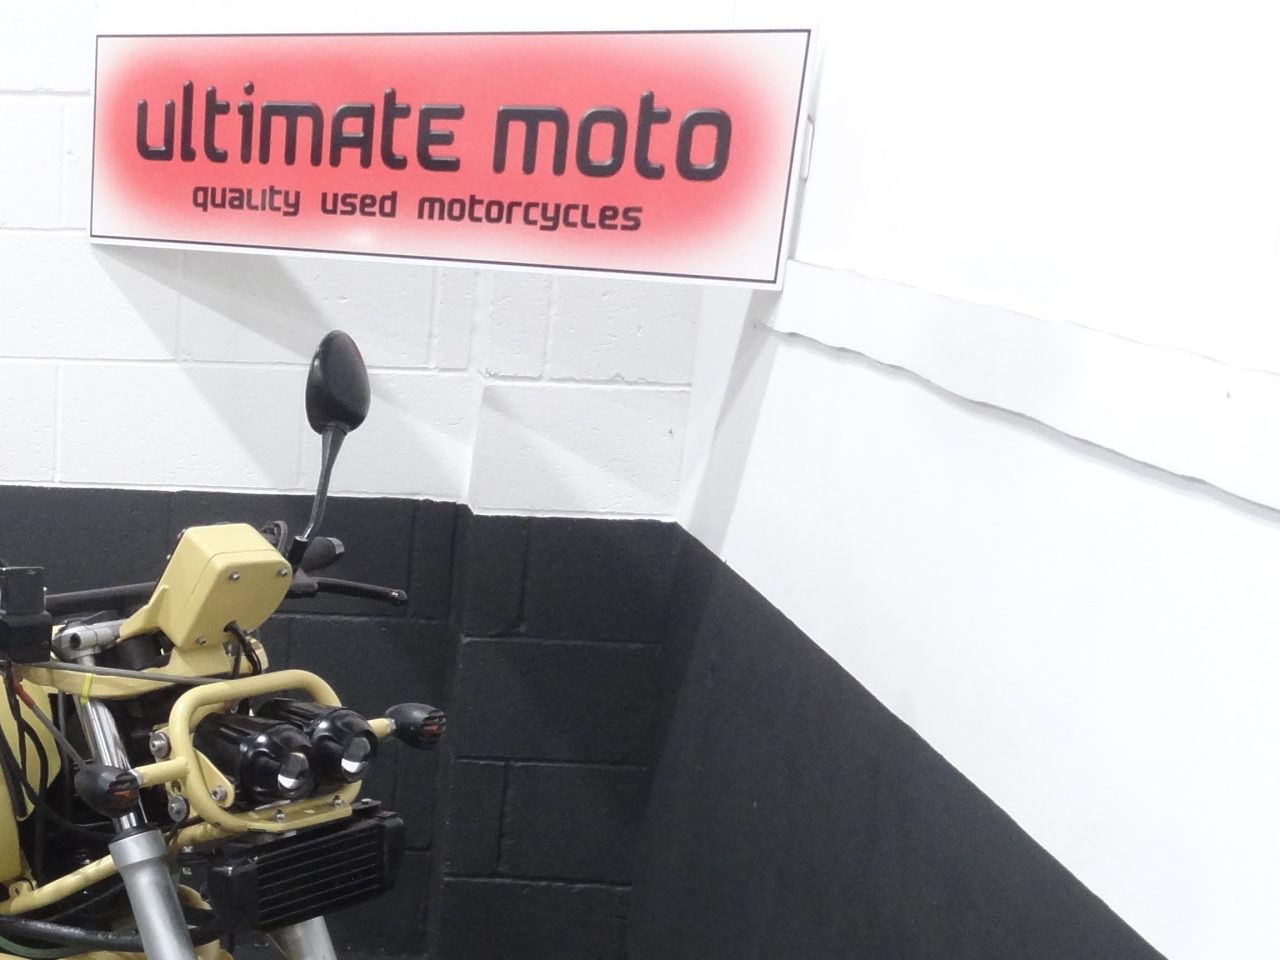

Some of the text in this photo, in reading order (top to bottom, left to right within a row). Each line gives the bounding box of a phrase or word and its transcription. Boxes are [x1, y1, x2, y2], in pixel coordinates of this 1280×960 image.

[492, 90, 732, 182] moto
[192, 185, 643, 231] quality used motorcycles
